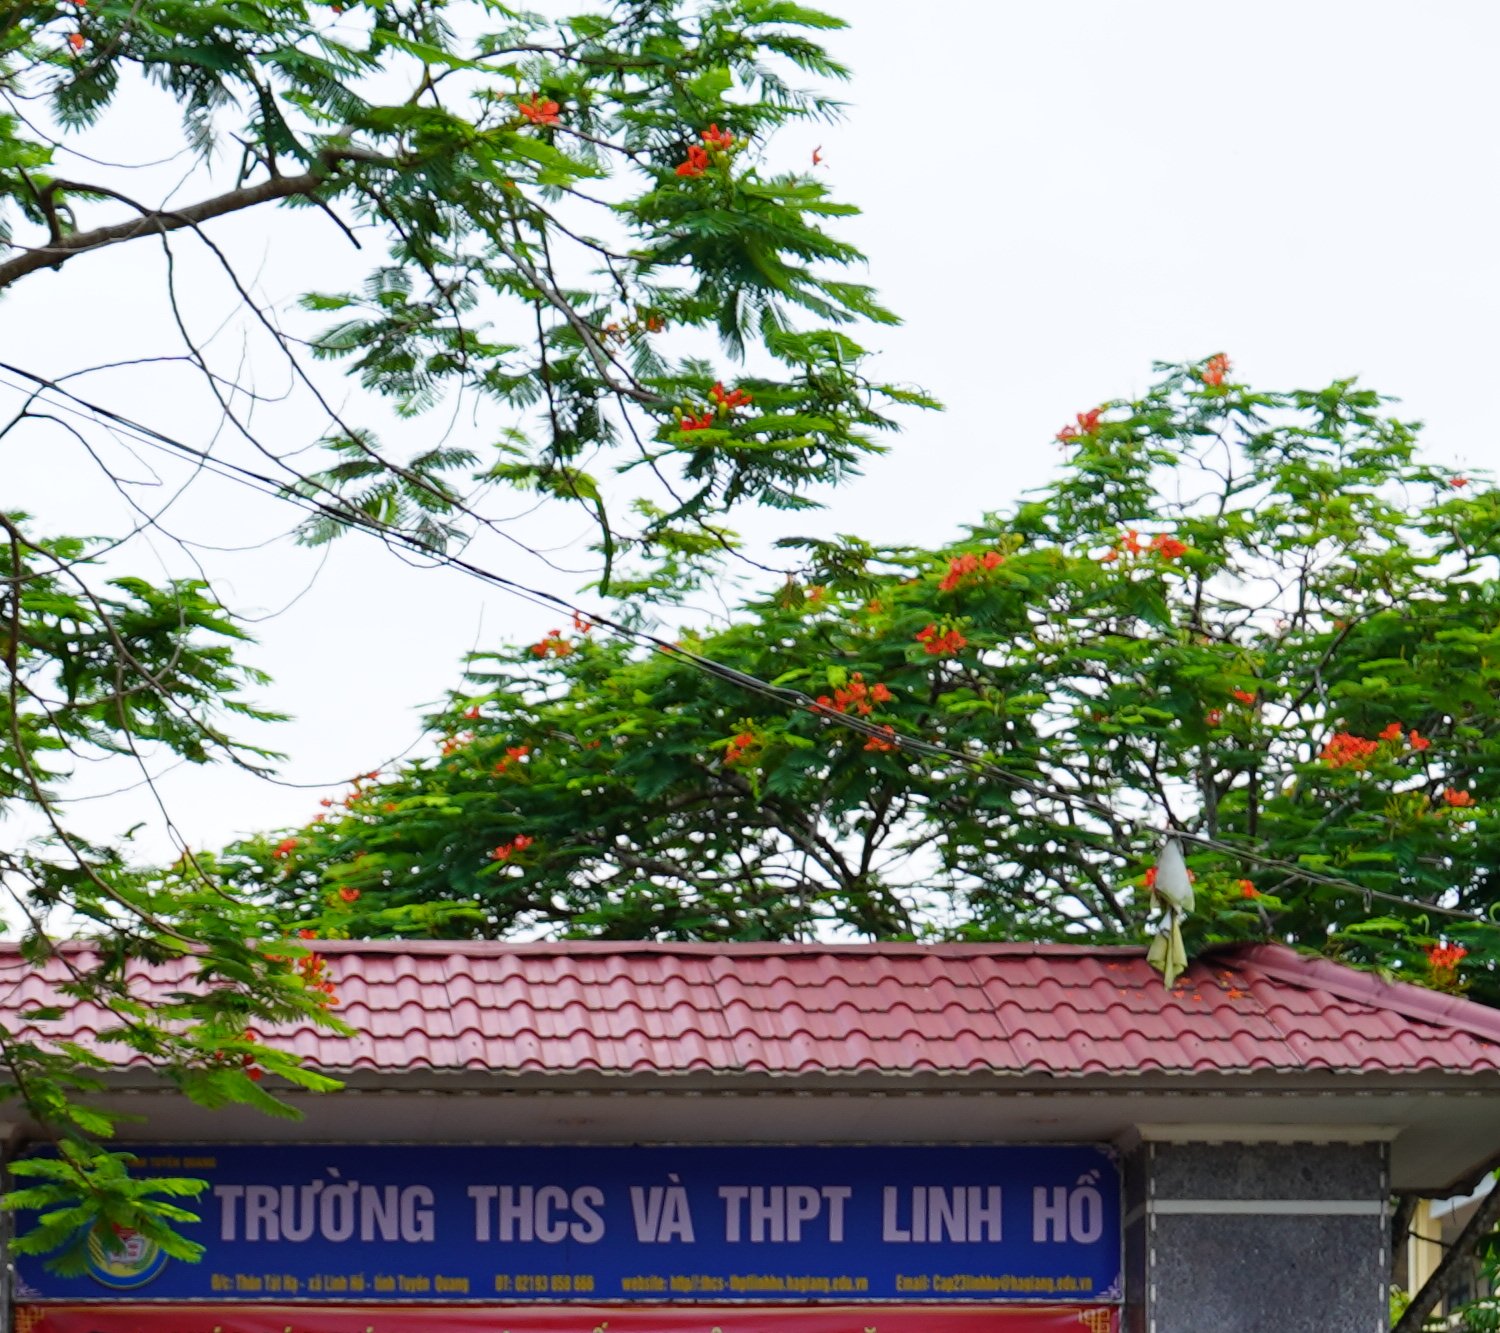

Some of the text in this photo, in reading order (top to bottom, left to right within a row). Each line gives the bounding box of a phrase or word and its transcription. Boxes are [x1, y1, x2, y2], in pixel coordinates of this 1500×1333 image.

[213, 1166, 1103, 1244] TRƯỜNG THCS VÀ THPT LINH HỒ
